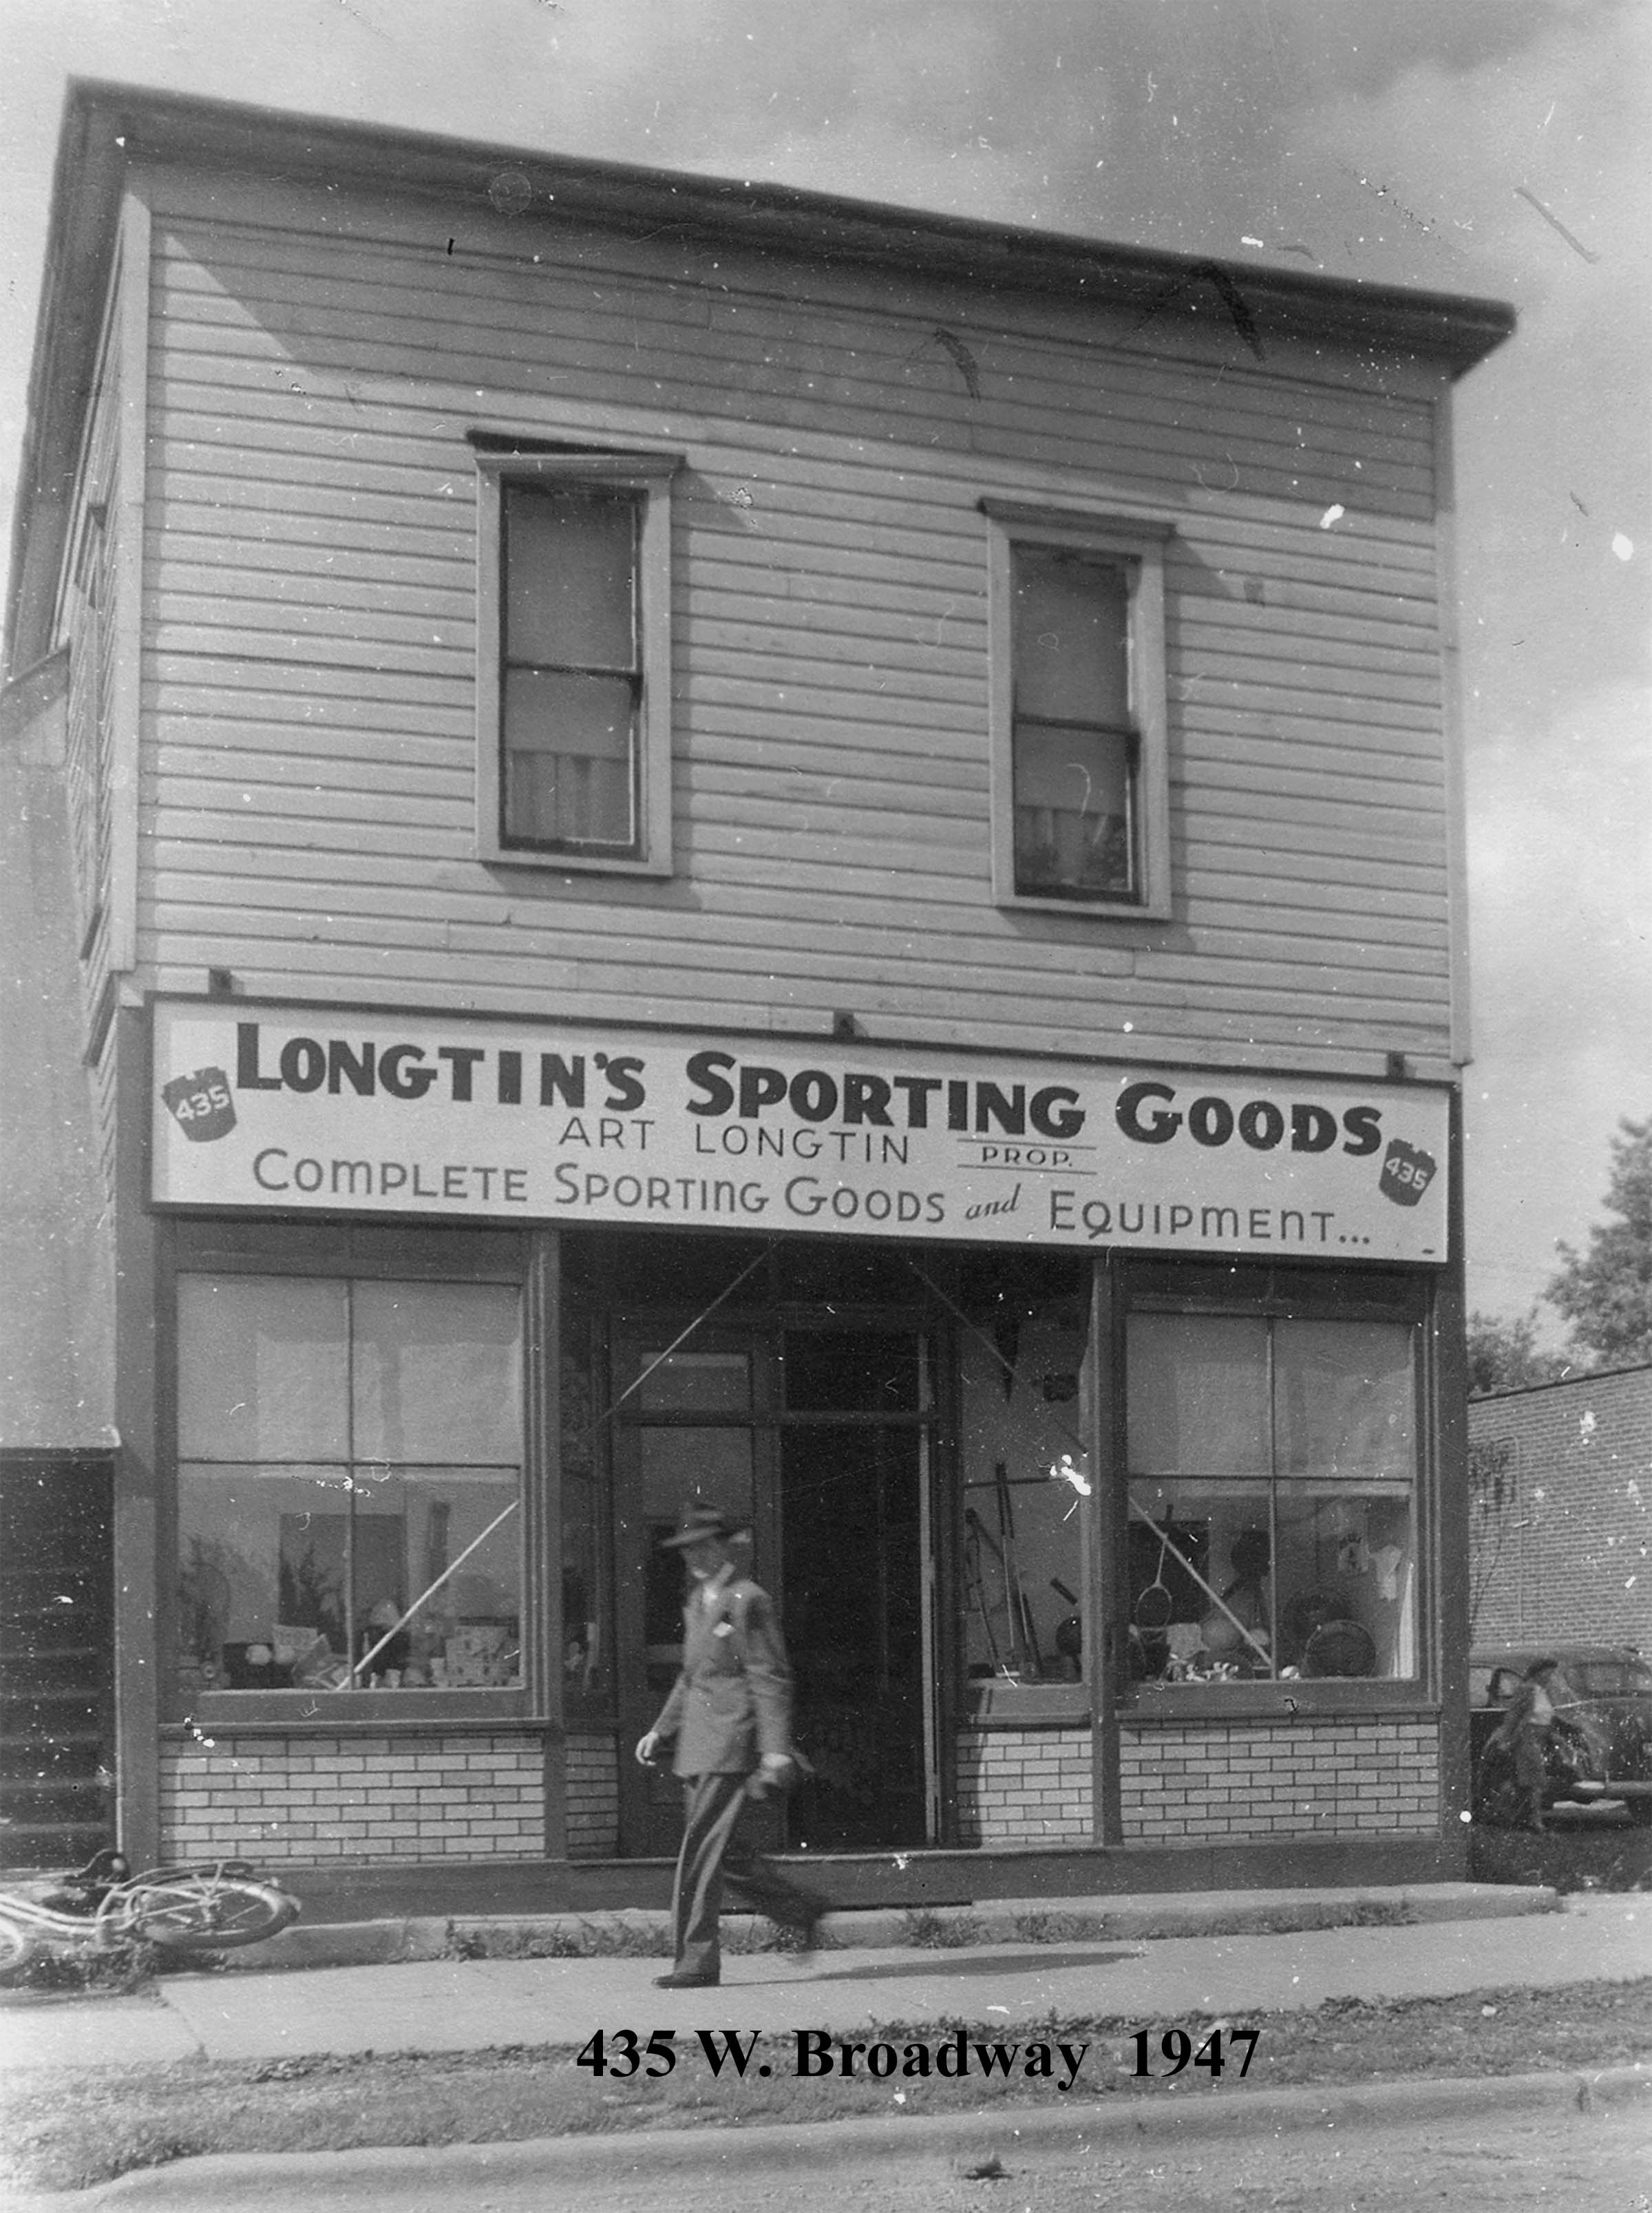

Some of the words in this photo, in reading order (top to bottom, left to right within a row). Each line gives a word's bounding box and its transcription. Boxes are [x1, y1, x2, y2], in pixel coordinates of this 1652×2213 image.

[173, 1085, 231, 1123] 435
[236, 1022, 646, 1112] LONGTIN'S
[686, 1050, 1086, 1139] SPORTING
[1115, 1082, 1383, 1156] GOODS
[558, 1116, 655, 1150] ART
[695, 1124, 908, 1165] LONGTIN
[981, 1145, 1072, 1167] PROP.
[1385, 1156, 1428, 1192] 435
[785, 1176, 946, 1224] GOODS
[965, 1183, 1021, 1220] and
